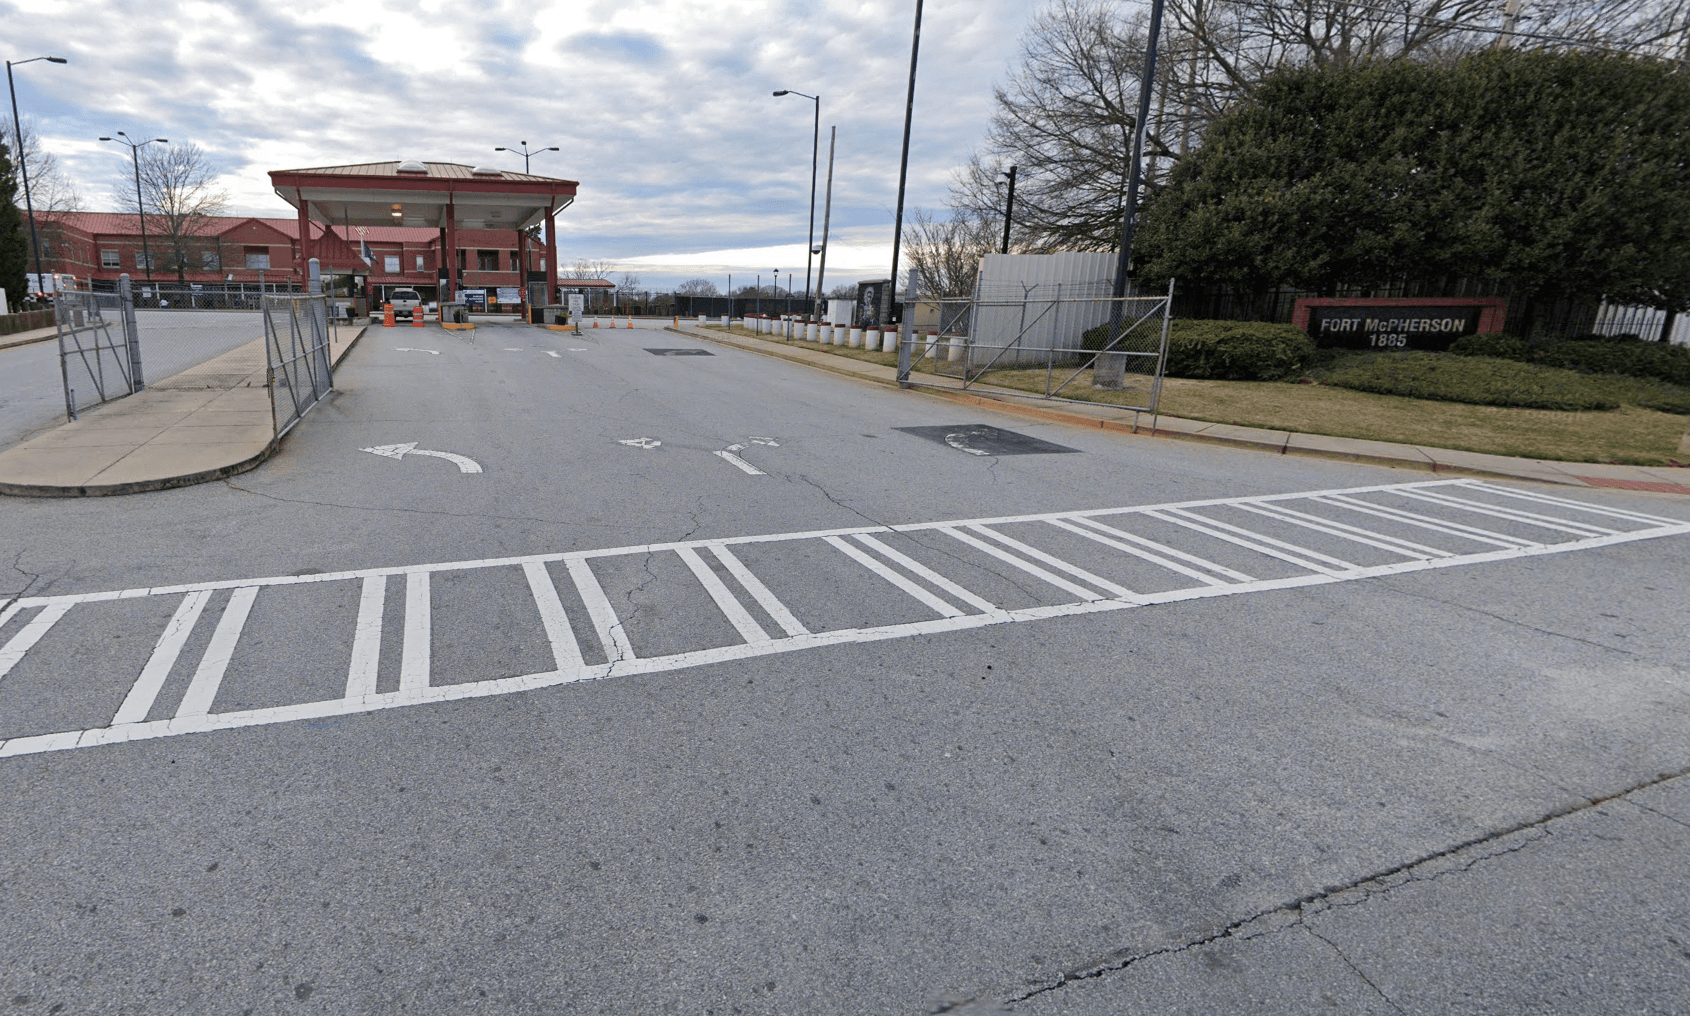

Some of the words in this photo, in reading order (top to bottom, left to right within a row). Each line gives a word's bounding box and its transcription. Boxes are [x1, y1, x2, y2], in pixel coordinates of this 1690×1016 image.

[1320, 318, 1361, 331] FORT
[1364, 318, 1465, 331] McPHERSON
[1369, 334, 1407, 346] 1885
